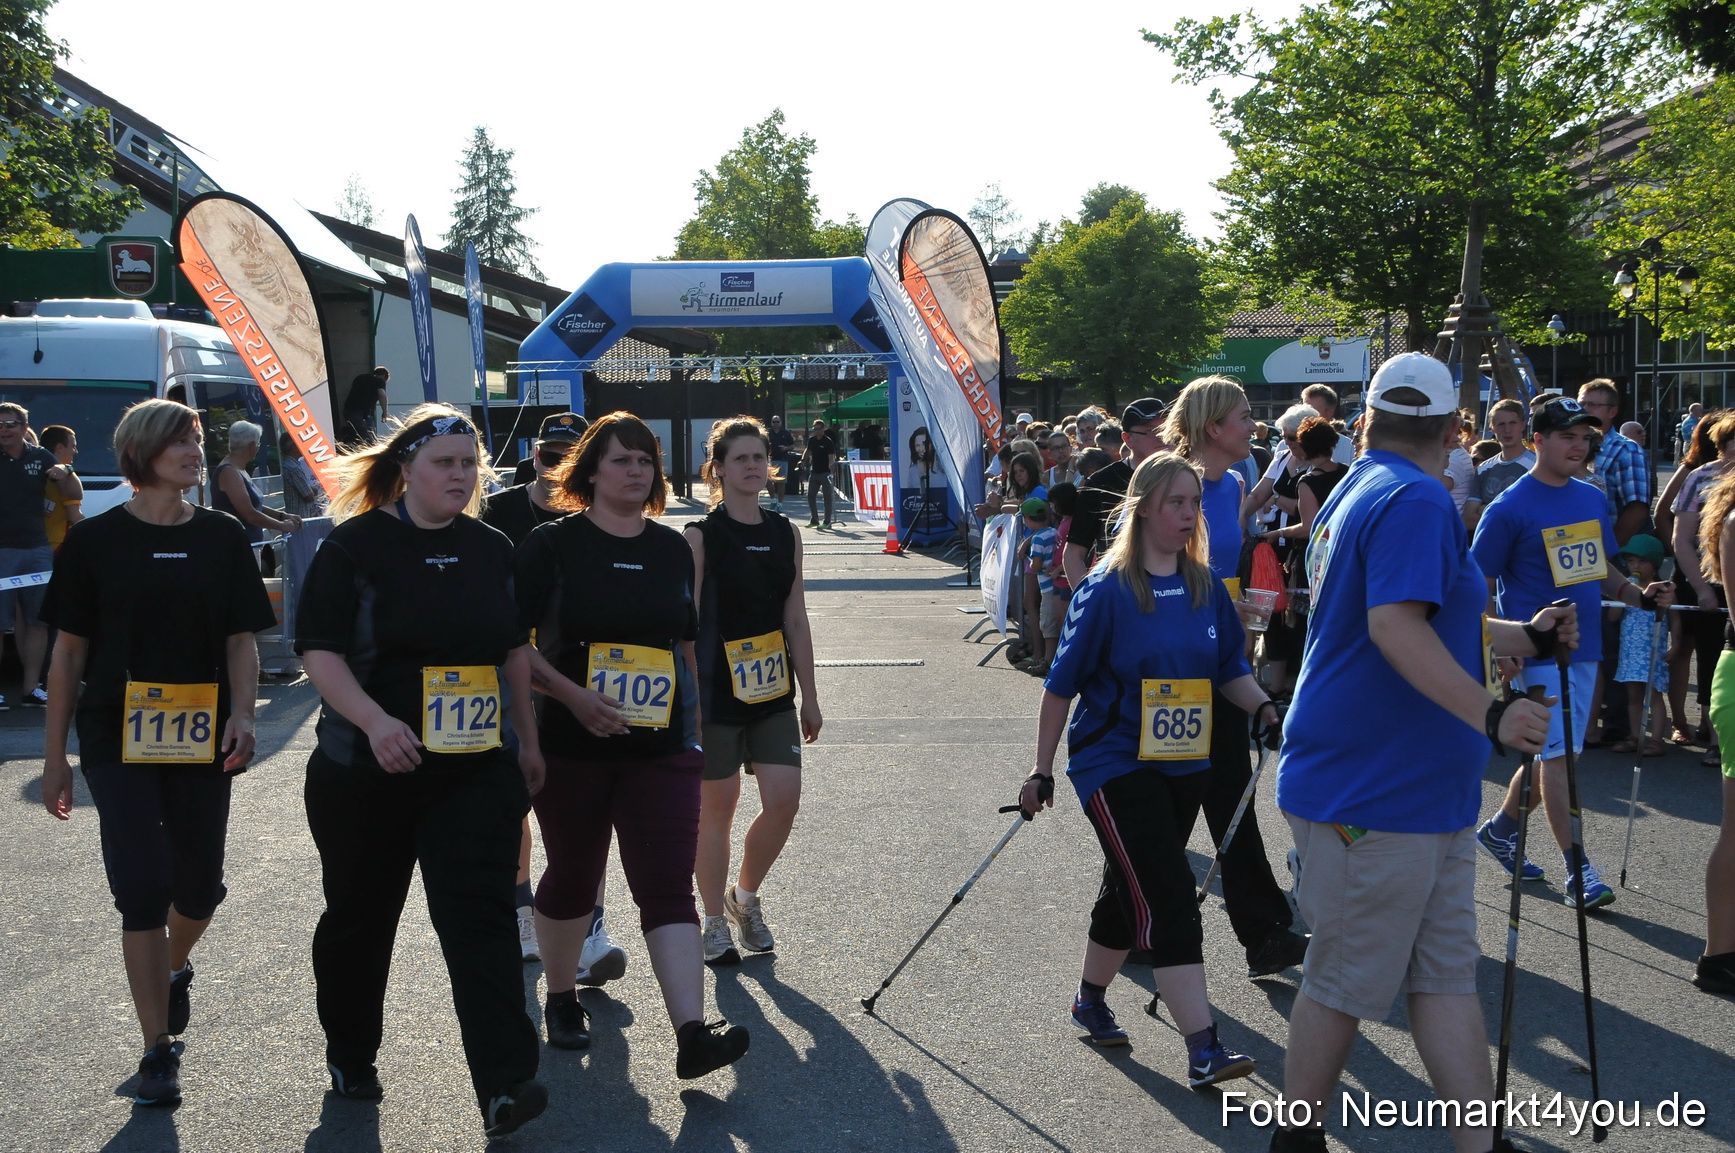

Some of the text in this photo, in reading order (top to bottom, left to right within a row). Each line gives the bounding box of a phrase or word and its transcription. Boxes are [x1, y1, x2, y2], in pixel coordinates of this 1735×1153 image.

[709, 292, 783, 306] firmenlauf
[565, 319, 606, 329] Fischer
[1304, 366, 1344, 374] Lammsbräu
[1558, 541, 1598, 570] 679
[1153, 586, 1185, 598] hummel
[734, 652, 784, 688] 1121
[591, 671, 671, 707] 1102
[127, 710, 211, 743] 1118
[428, 696, 498, 731] 1122
[1152, 708, 1202, 740] 685
